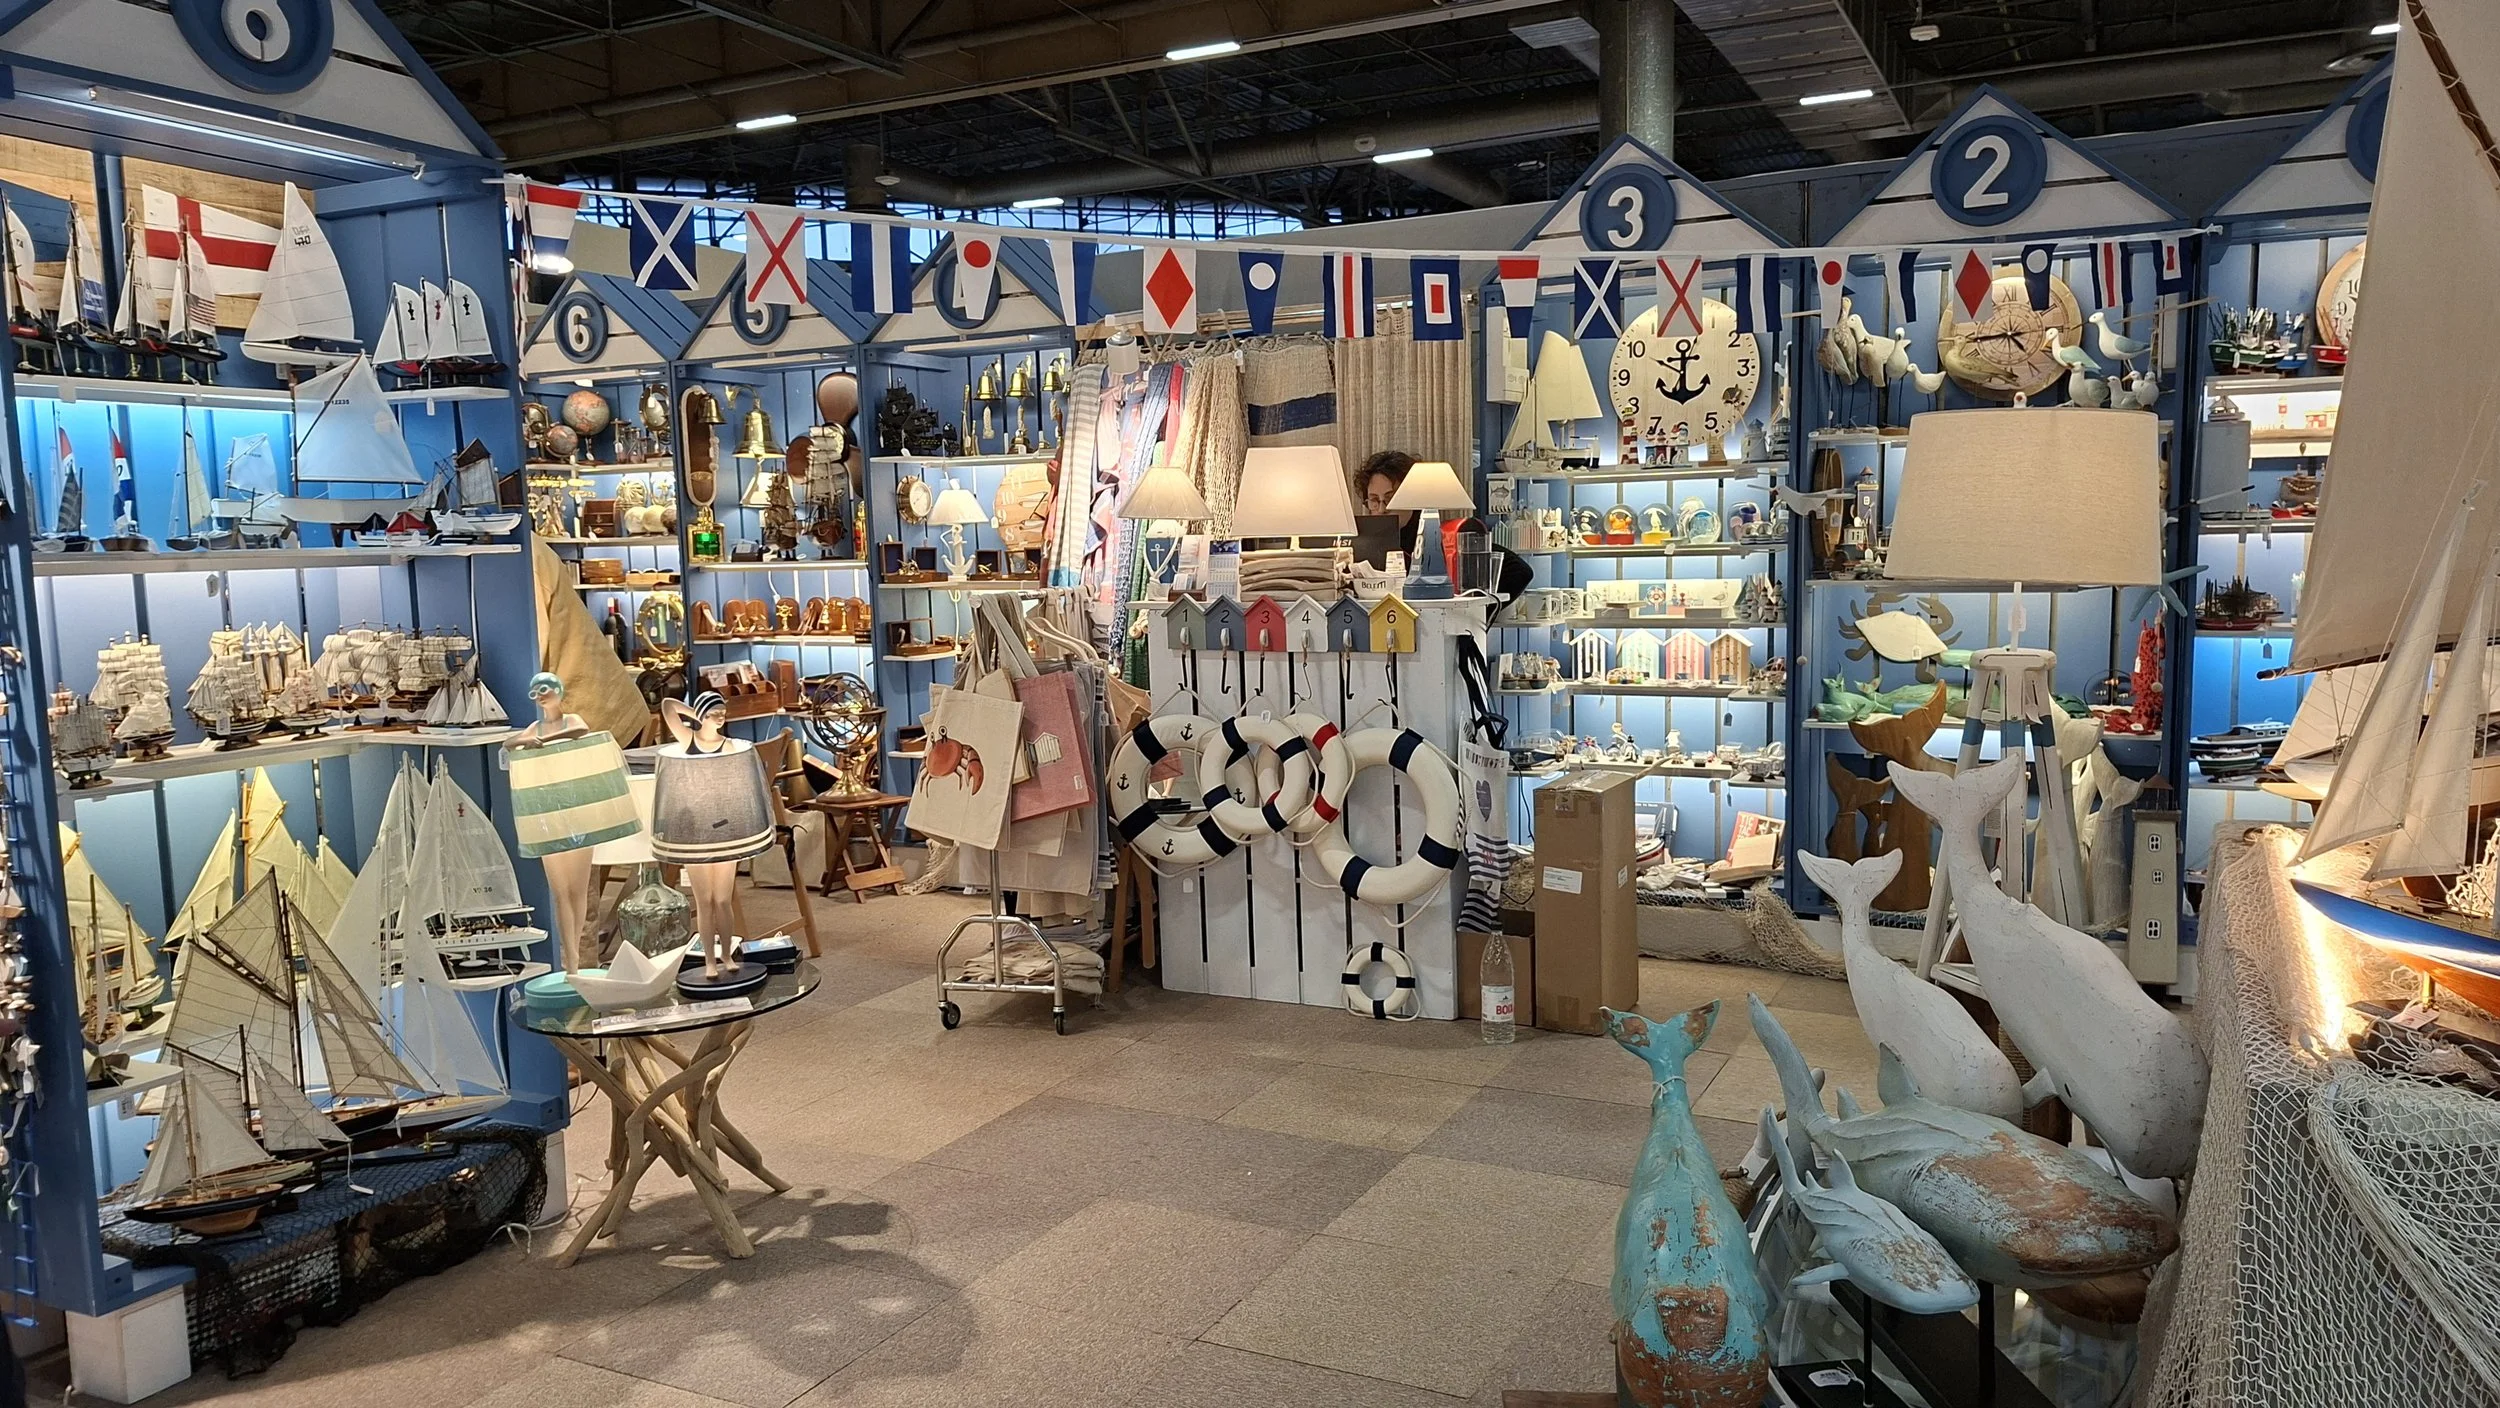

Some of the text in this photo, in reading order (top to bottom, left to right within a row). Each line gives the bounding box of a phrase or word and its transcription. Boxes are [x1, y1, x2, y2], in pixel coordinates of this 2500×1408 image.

[1963, 135, 2011, 208] 2
[1608, 186, 1643, 248] 3
[567, 305, 591, 352] 6
[1728, 331, 1740, 348] 2
[1627, 340, 1646, 358] 10
[1737, 359, 1750, 377] 3
[1618, 369, 1630, 386] 9
[1650, 417, 1662, 435] 7
[1704, 412, 1718, 430] 5
[997, 509, 1007, 523] 9
[1005, 528, 1015, 541] 8
[1182, 609, 1396, 624] 1 2 3 4 5 6
